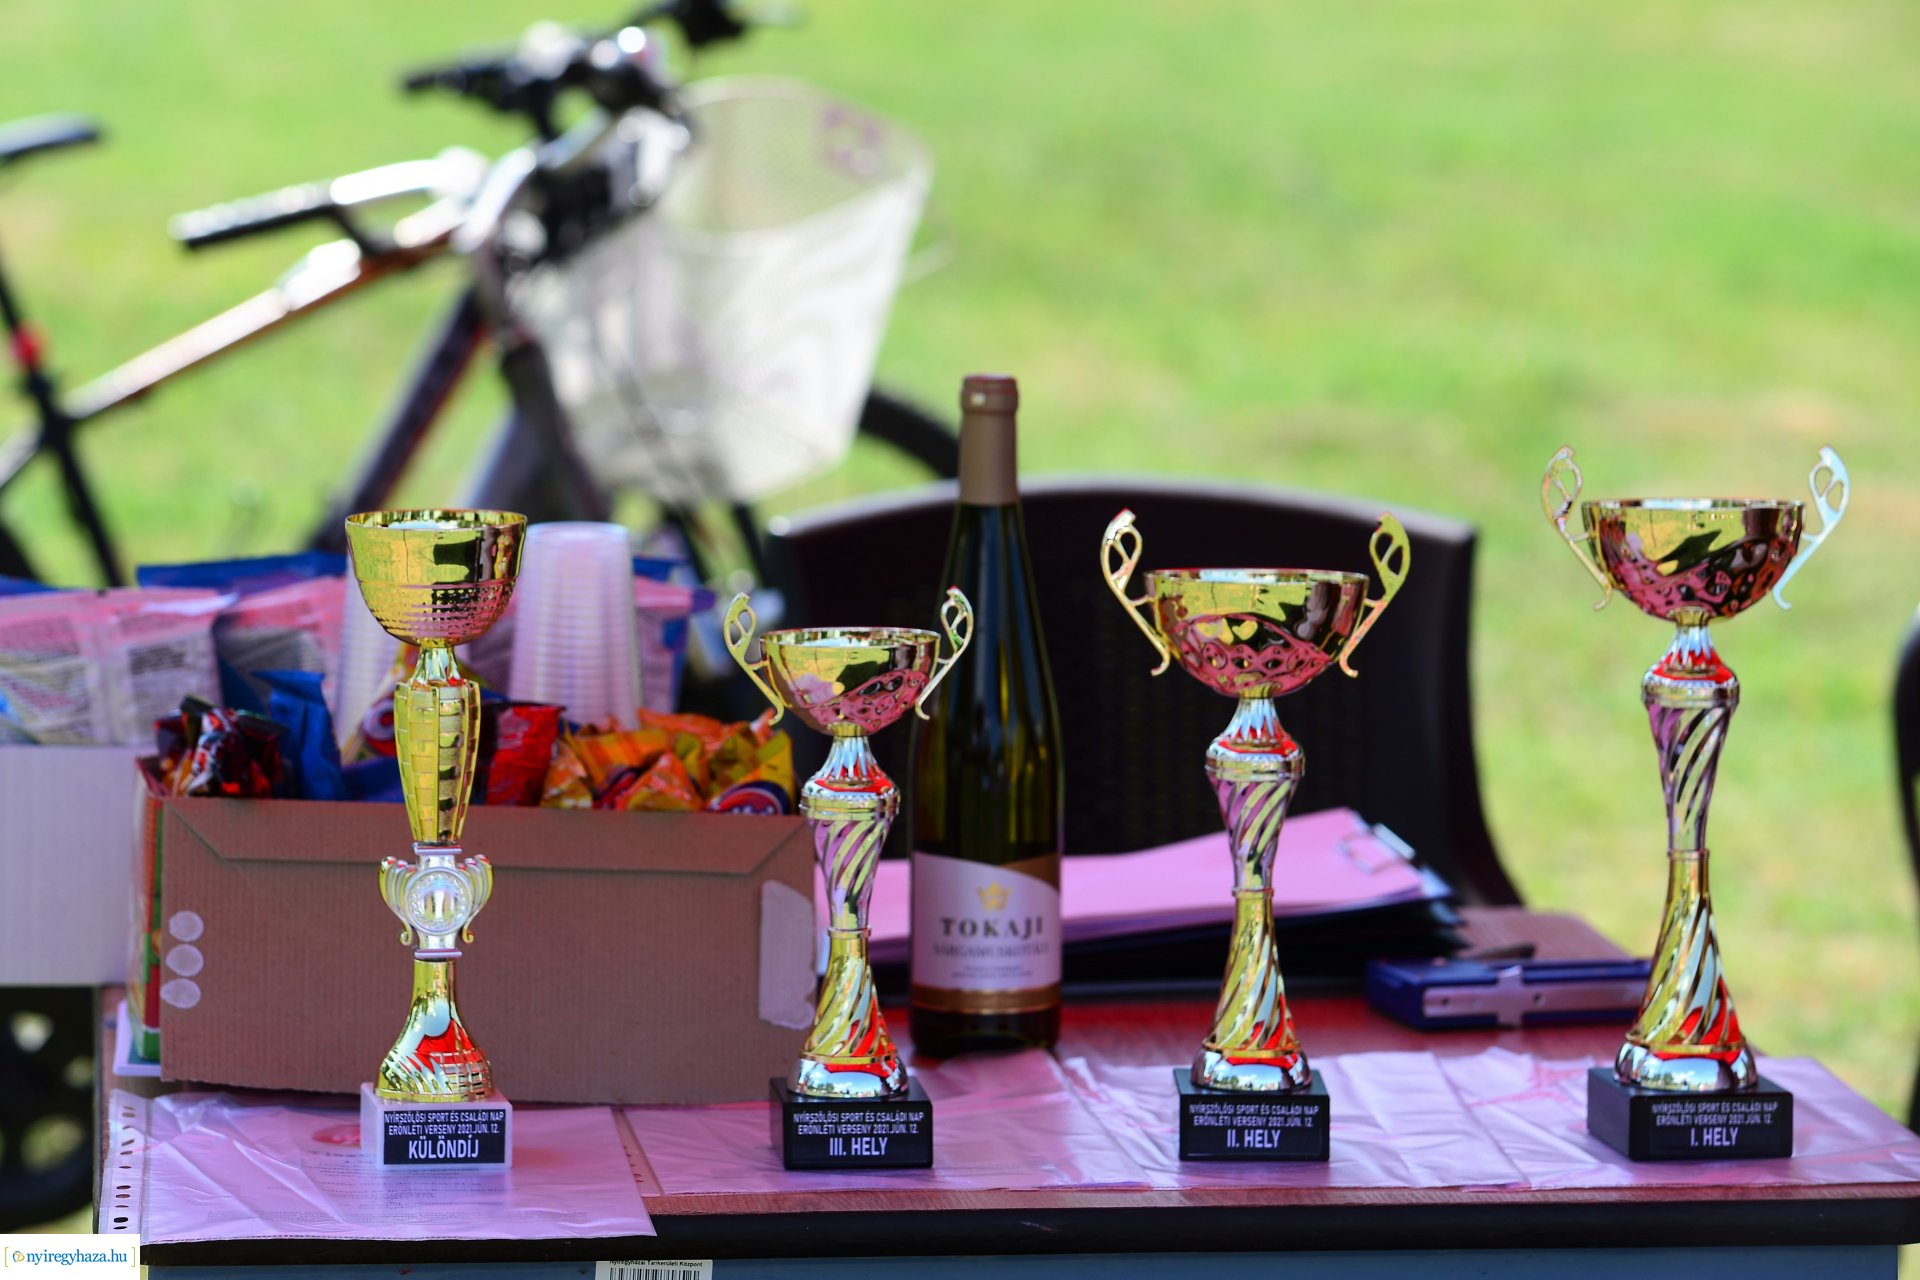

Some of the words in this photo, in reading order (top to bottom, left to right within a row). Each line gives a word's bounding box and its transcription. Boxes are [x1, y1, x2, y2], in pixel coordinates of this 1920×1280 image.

[940, 916, 1043, 939] TOKAJI
[1236, 1105, 1258, 1114] SPORT
[1260, 1103, 1269, 1114] ÉS
[1304, 1106, 1319, 1114] NAP
[428, 1113, 448, 1122] SPORT
[451, 1111, 459, 1122] ÉS
[461, 1110, 488, 1121] CSALÁDI
[490, 1112, 504, 1121] NAP
[841, 1112, 864, 1122] SPORT
[865, 1111, 874, 1121] ÉS
[876, 1110, 907, 1121] CSALÁDI
[909, 1112, 924, 1121] NAP
[1233, 1116, 1266, 1126] VERSENY
[425, 1125, 455, 1134] VERSENY
[491, 1124, 500, 1133] 12.
[837, 1125, 871, 1134] VERSENY
[1227, 1129, 1240, 1148] II.
[1244, 1130, 1280, 1148] HELY
[1691, 1128, 1698, 1146] I.
[1703, 1127, 1738, 1146] HELY
[409, 1134, 479, 1159] KÜLÖNDÍJ
[830, 1138, 846, 1155] III.
[852, 1138, 888, 1155] HELY
